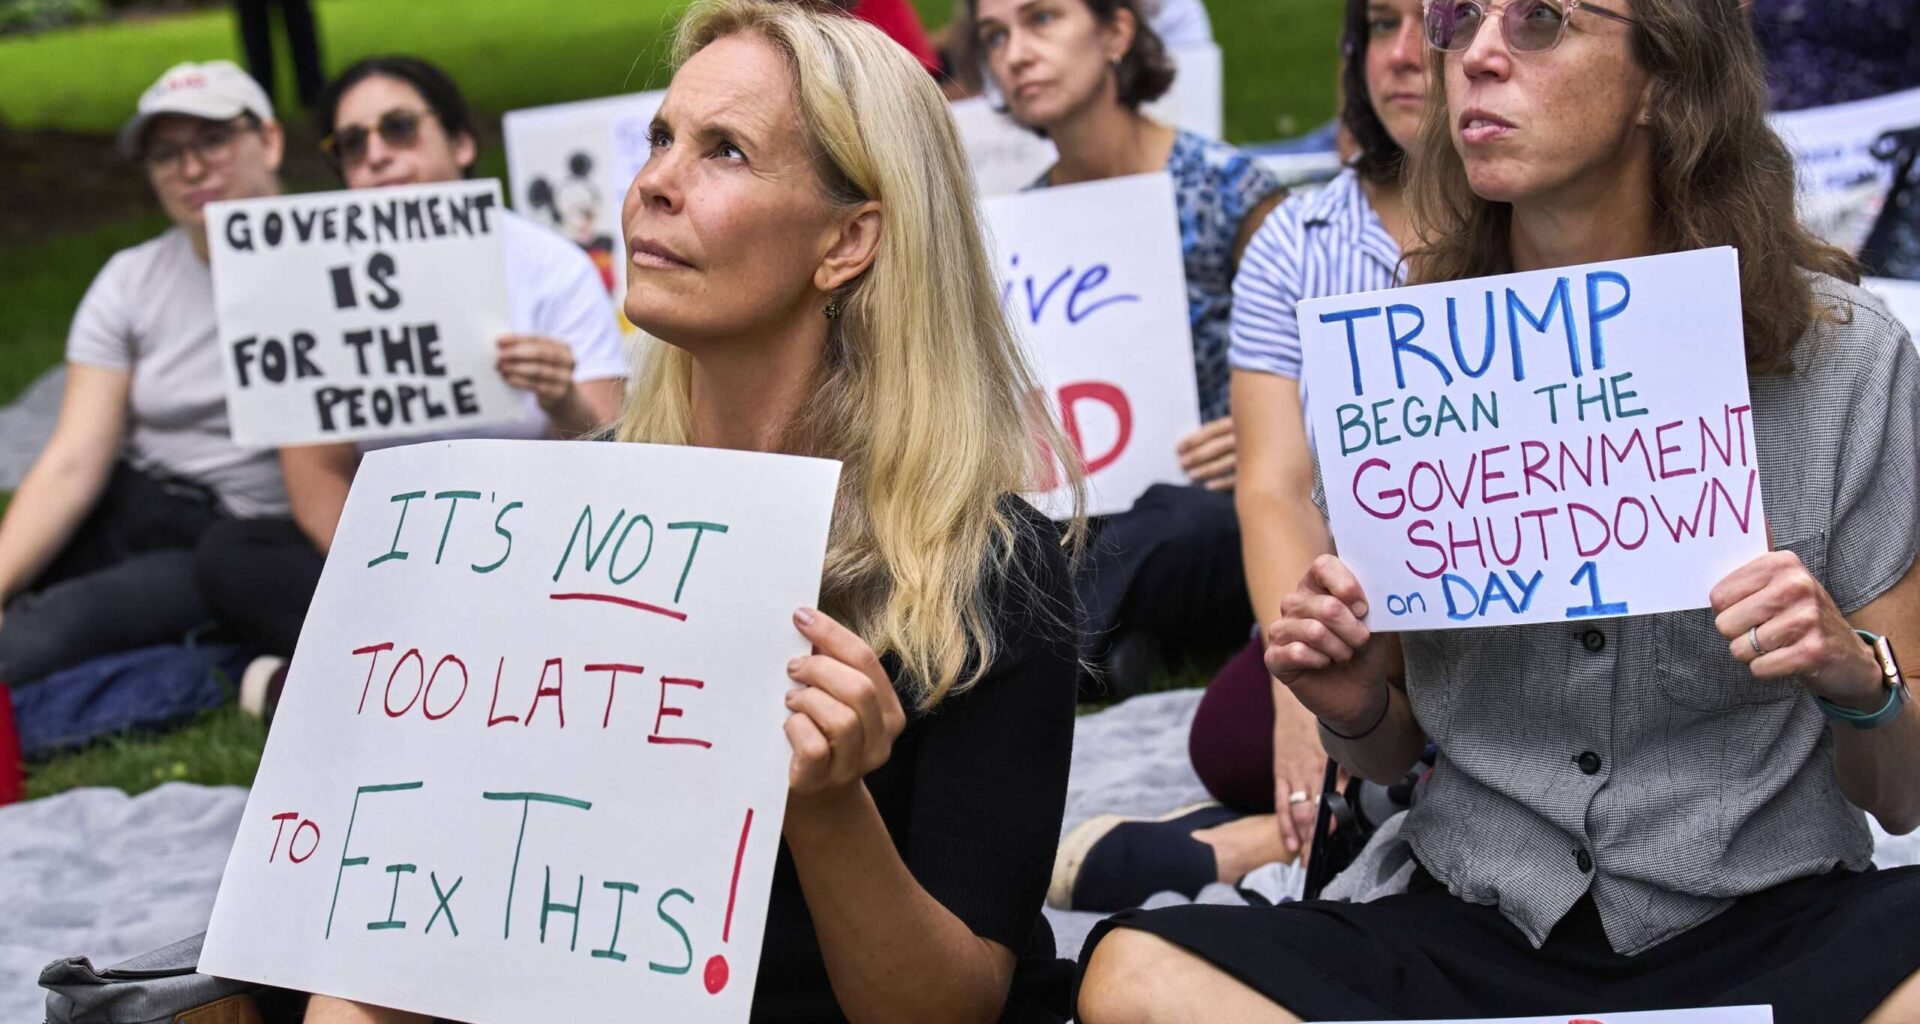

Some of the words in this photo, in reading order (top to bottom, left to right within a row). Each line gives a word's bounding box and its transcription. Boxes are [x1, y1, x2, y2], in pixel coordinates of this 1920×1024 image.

[226, 193, 494, 251] GOVERNMENT
[330, 253, 401, 310] IS
[1000, 253, 1141, 324] ive
[233, 332, 323, 387] FOR
[345, 324, 446, 376] THE
[1319, 271, 1631, 396] TRUMP
[315, 379, 479, 430] PEOPLE
[1336, 391, 1499, 456] BEGAN
[1534, 371, 1649, 425] THE
[1352, 404, 1752, 520] GOVERNMENT
[367, 490, 524, 574] IT'S
[551, 504, 729, 604] NOT
[1405, 469, 1757, 579] SHUTDOWN
[1386, 590, 1426, 616] on
[1441, 569, 1544, 621] DAY
[1566, 561, 1629, 618] 1
[352, 641, 469, 721] TOO
[487, 656, 713, 750] LATE
[269, 811, 321, 864] TO
